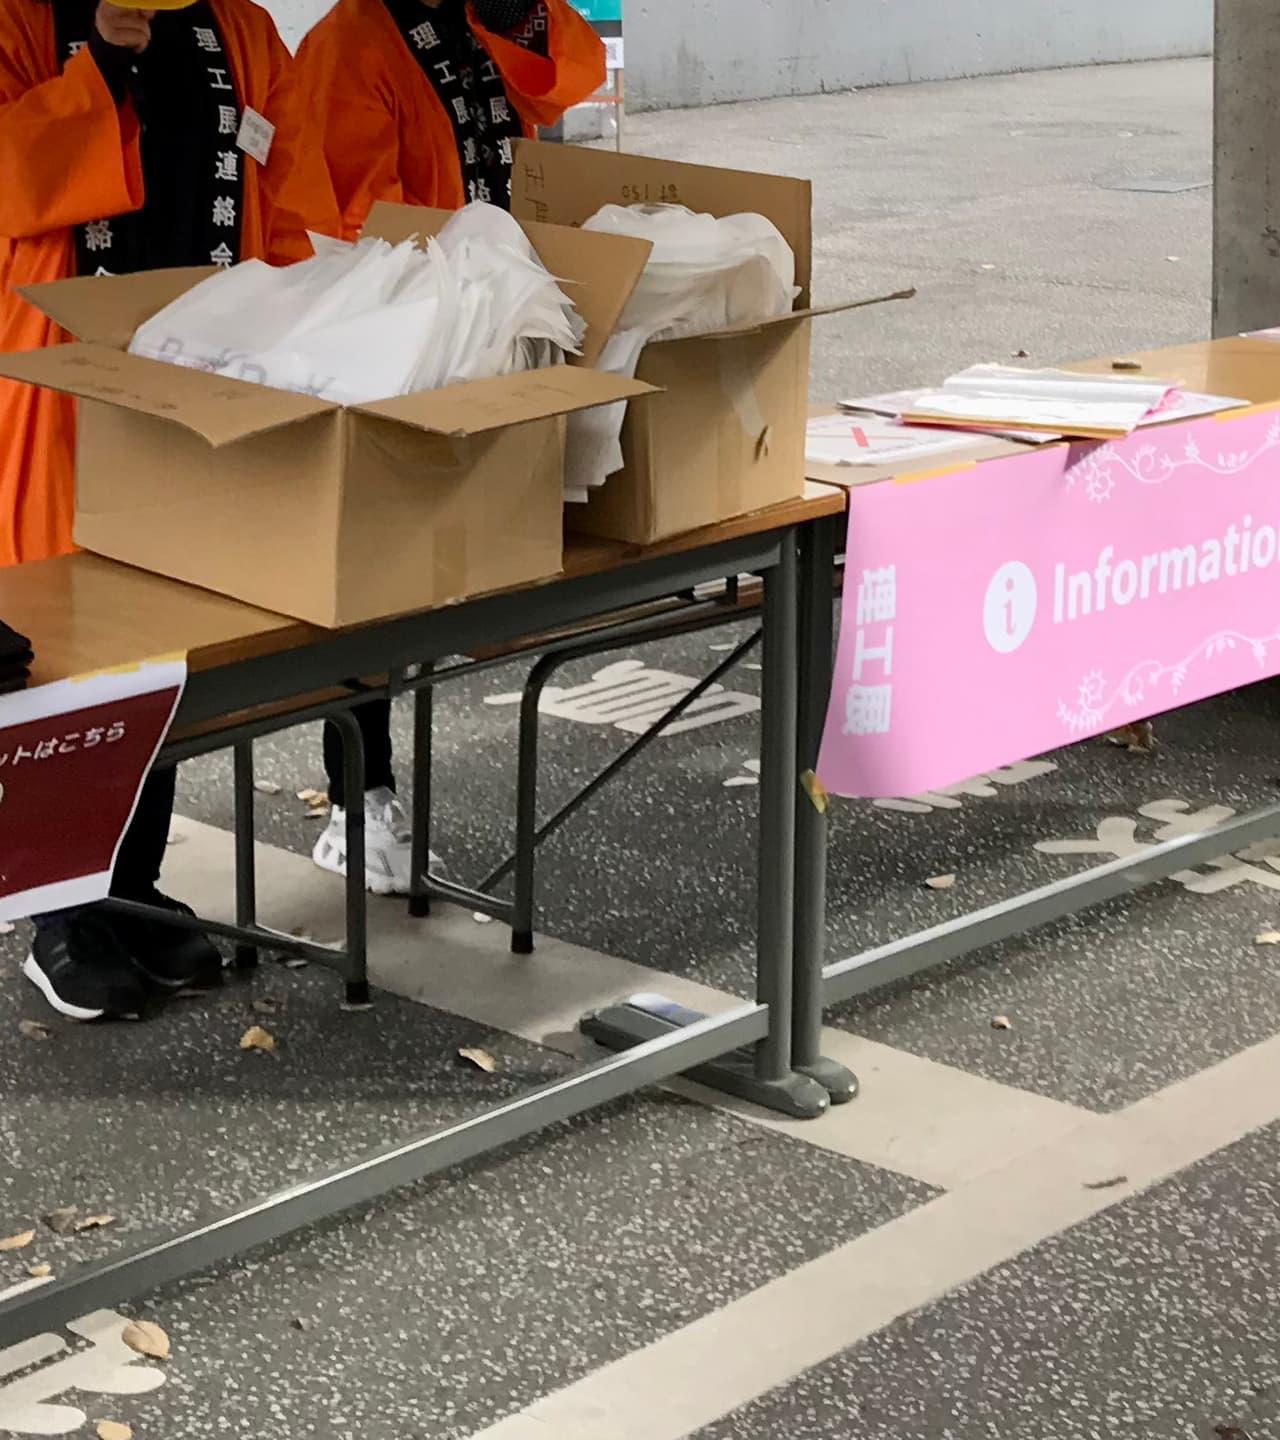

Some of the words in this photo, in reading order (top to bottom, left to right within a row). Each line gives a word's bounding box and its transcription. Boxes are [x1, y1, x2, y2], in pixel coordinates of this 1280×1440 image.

[192, 24, 238, 270] 理工展連絡会
[842, 564, 897, 738] 理工展
